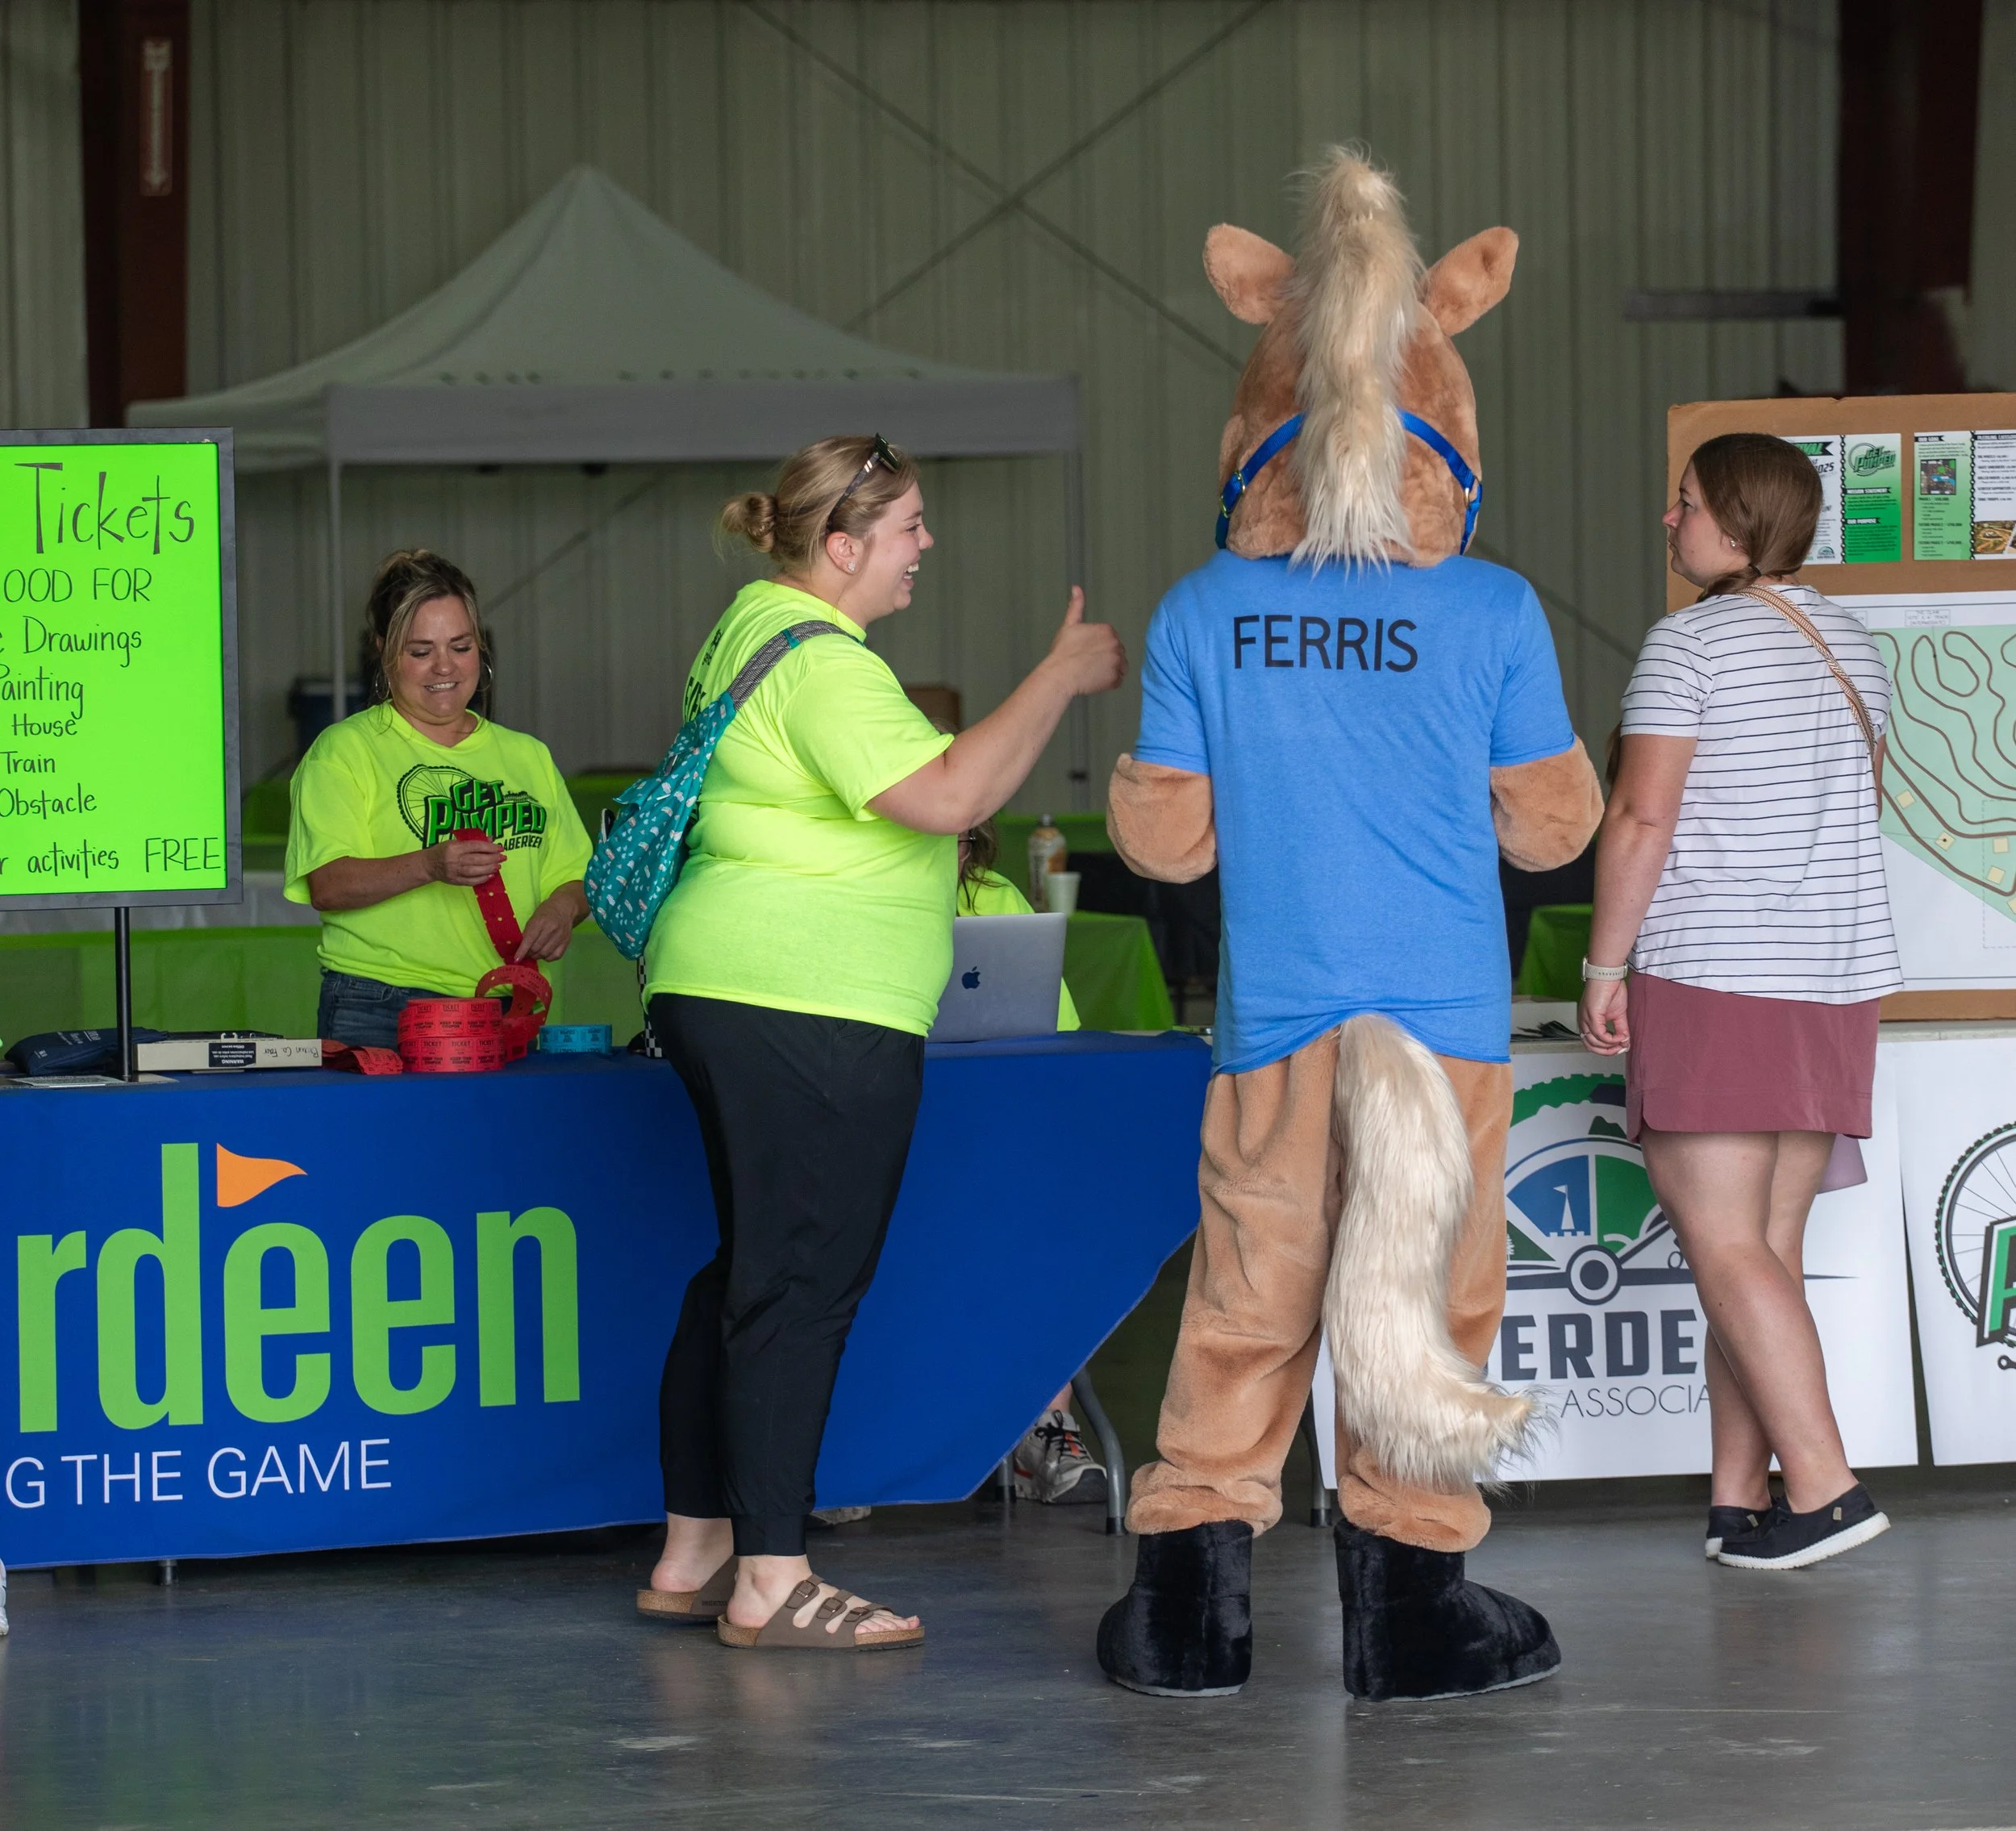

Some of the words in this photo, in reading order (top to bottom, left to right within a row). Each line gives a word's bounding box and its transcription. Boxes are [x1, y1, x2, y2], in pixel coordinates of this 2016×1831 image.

[14, 462, 195, 555] Tickets
[94, 568, 152, 603] FOR
[23, 615, 143, 668] Drawings
[1234, 615, 1418, 674] FERRIS
[11, 713, 78, 737] House
[0, 751, 56, 774] Train
[0, 782, 98, 820] Obstacle
[450, 779, 504, 811] GET
[27, 839, 120, 879] activities
[18, 1142, 581, 1433] rdeen
[1485, 1309, 1697, 1382] ERDE
[60, 1450, 183, 1506] THE
[207, 1438, 392, 1499] GAME
